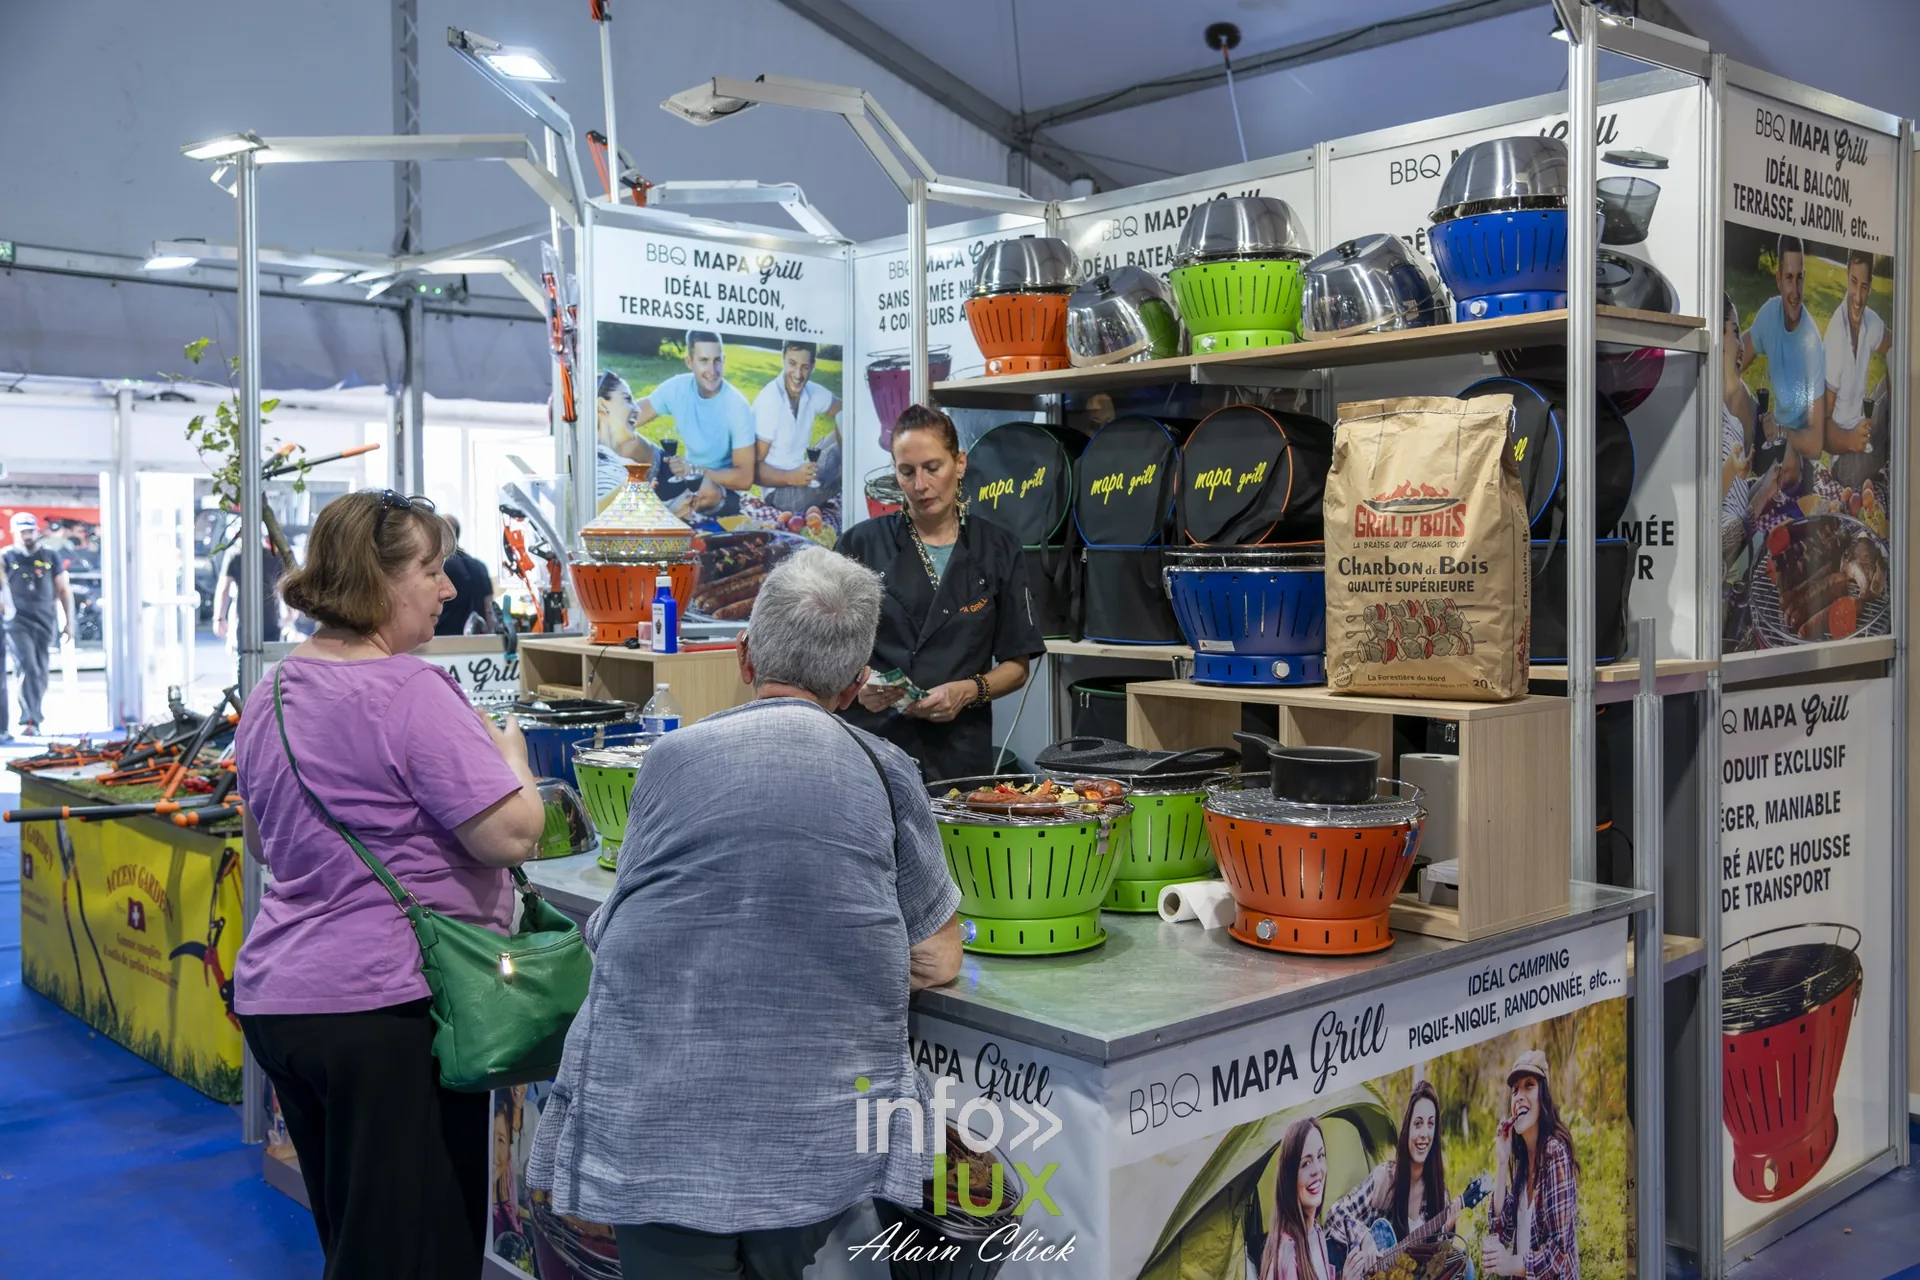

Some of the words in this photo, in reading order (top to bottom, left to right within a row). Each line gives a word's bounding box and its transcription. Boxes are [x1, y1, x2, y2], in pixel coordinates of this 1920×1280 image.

[1756, 108, 1785, 143] BBQ
[1789, 119, 1830, 156] MAPA
[1834, 128, 1868, 171] Grill
[1390, 154, 1441, 185] BBQ
[1766, 155, 1799, 191] IDÉAL
[1804, 168, 1852, 207] BALCON,
[1733, 183, 1796, 227] TERRASSE,
[1801, 201, 1846, 238] JARDIN,
[1851, 216, 1879, 242] etc...
[646, 243, 687, 266] BBQ
[693, 249, 750, 274] MAPA
[756, 254, 803, 285] Grill
[1127, 243, 1177, 269] BATEA
[664, 274, 711, 300] IDÉAL
[718, 283, 785, 310] BALCON,
[878, 289, 910, 311] SANS
[619, 295, 710, 325] TERRASSE,
[716, 306, 779, 332] JARDIN,
[785, 316, 824, 335] etc...
[879, 316, 886, 333] 4
[978, 476, 1014, 510] mapa
[1020, 466, 1047, 499] grill
[1090, 472, 1124, 505] mapa
[1127, 464, 1157, 496] grill
[1194, 466, 1232, 502] mapa
[1236, 461, 1268, 494] grill
[1364, 541, 1390, 549] BRAISE
[1393, 541, 1408, 549] QUI
[1411, 540, 1442, 549] CHANGE
[1446, 540, 1467, 549] TOUT
[1440, 555, 1489, 575] Bois
[1347, 577, 1392, 593] QUALITÉ
[1395, 577, 1475, 593] SUPÉRIEURE
[468, 658, 520, 691] Gril
[1743, 702, 1797, 732] MAPA
[1801, 693, 1850, 737] Grill
[1774, 744, 1846, 777] EXCLUSIF
[1765, 790, 1841, 825] MANIABLE
[1746, 845, 1785, 876] AVEC
[1789, 833, 1851, 867] HOUSSE
[1722, 886, 1740, 913] DE
[1745, 867, 1831, 907] TRANSPORT
[1468, 965, 1506, 997] IDÉAL
[1508, 948, 1570, 983] CAMPING
[1408, 1001, 1500, 1050] PIQUE-NIQUE,
[1503, 971, 1587, 1018] RANDONNÉE,
[1588, 969, 1621, 991] etc...
[974, 1042, 1053, 1108] Grill
[1128, 1072, 1203, 1136] BBQ
[1211, 1044, 1299, 1107] MAPA
[1310, 1002, 1388, 1094] Grill
